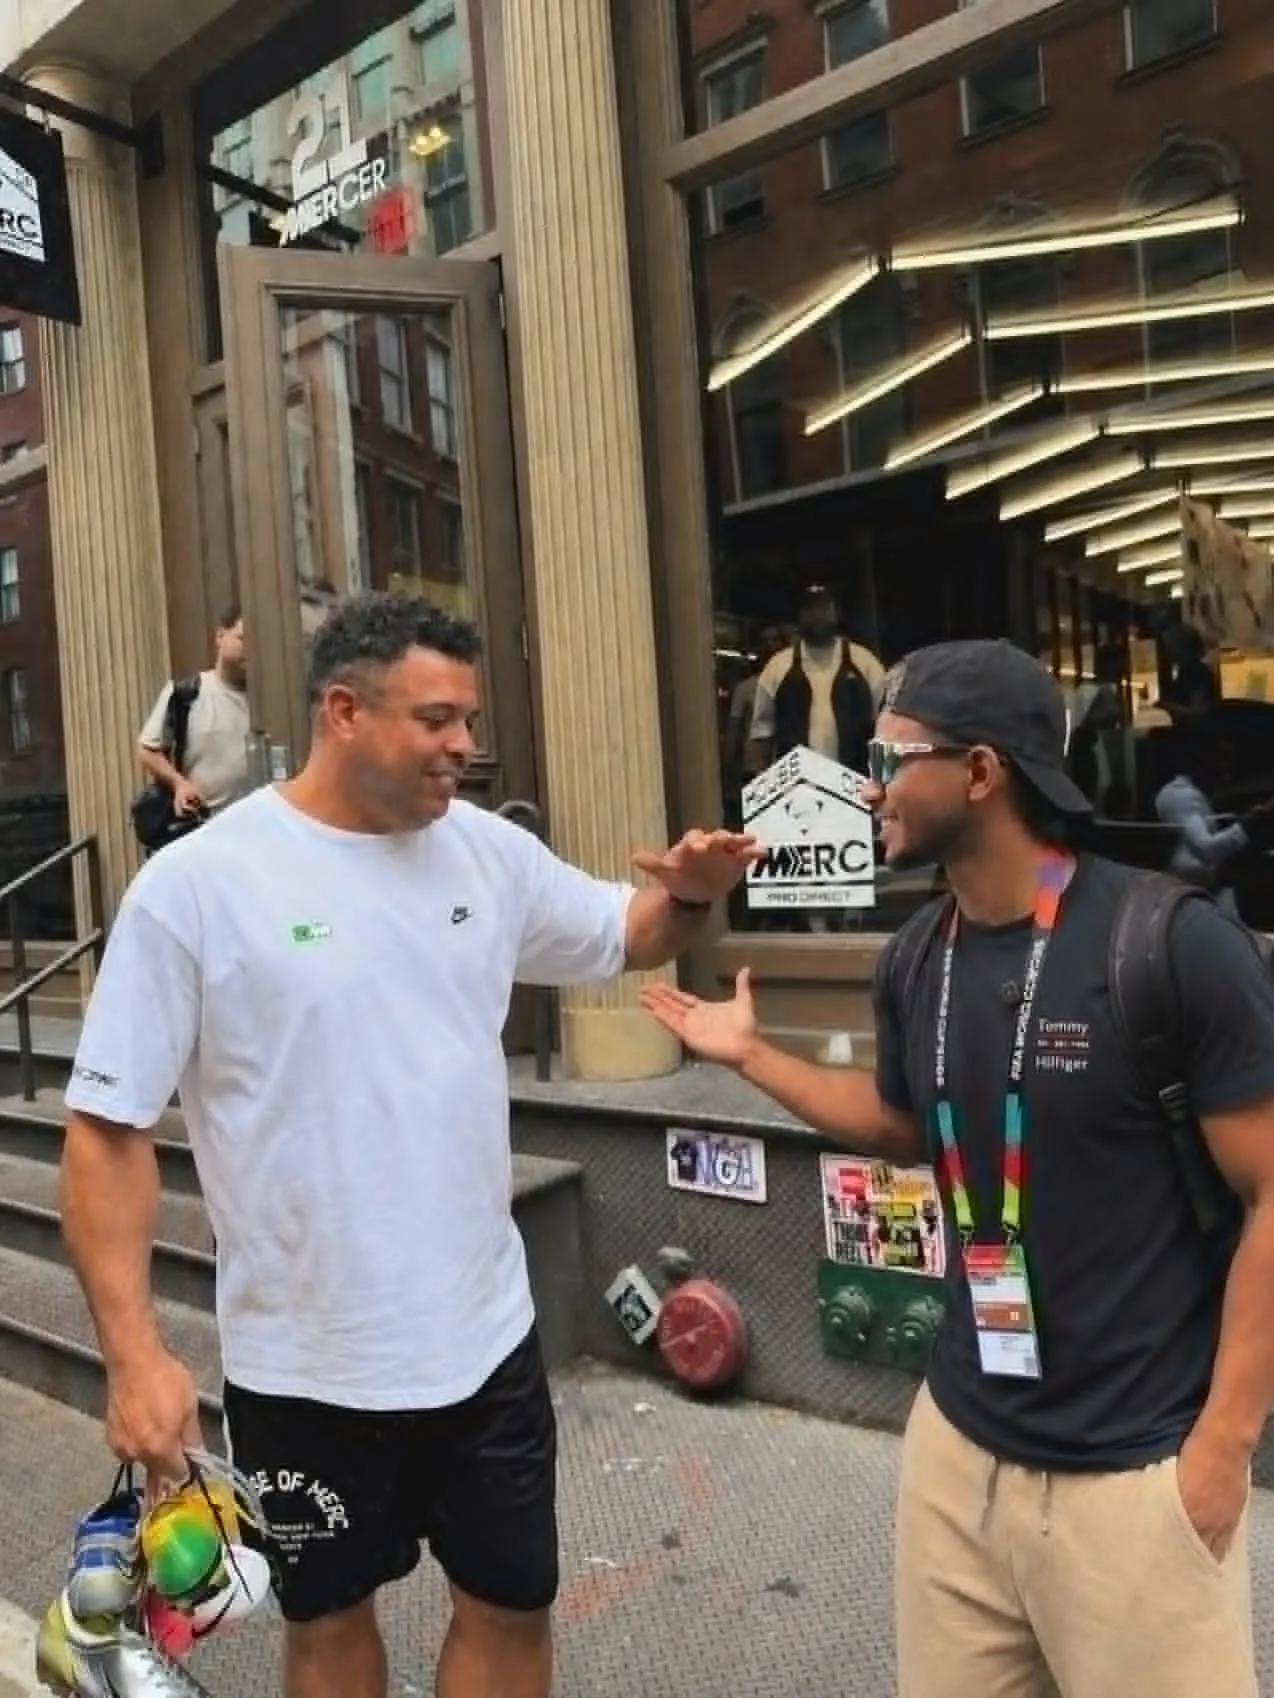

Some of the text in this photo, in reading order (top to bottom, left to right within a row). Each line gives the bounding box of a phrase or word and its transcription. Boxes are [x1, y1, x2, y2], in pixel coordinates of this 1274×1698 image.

[279, 157, 386, 247] MERCER
[0, 206, 38, 238] RC
[751, 839, 869, 879] MERC
[1038, 1018, 1089, 1039] Tommy
[277, 1469, 305, 1492] OF
